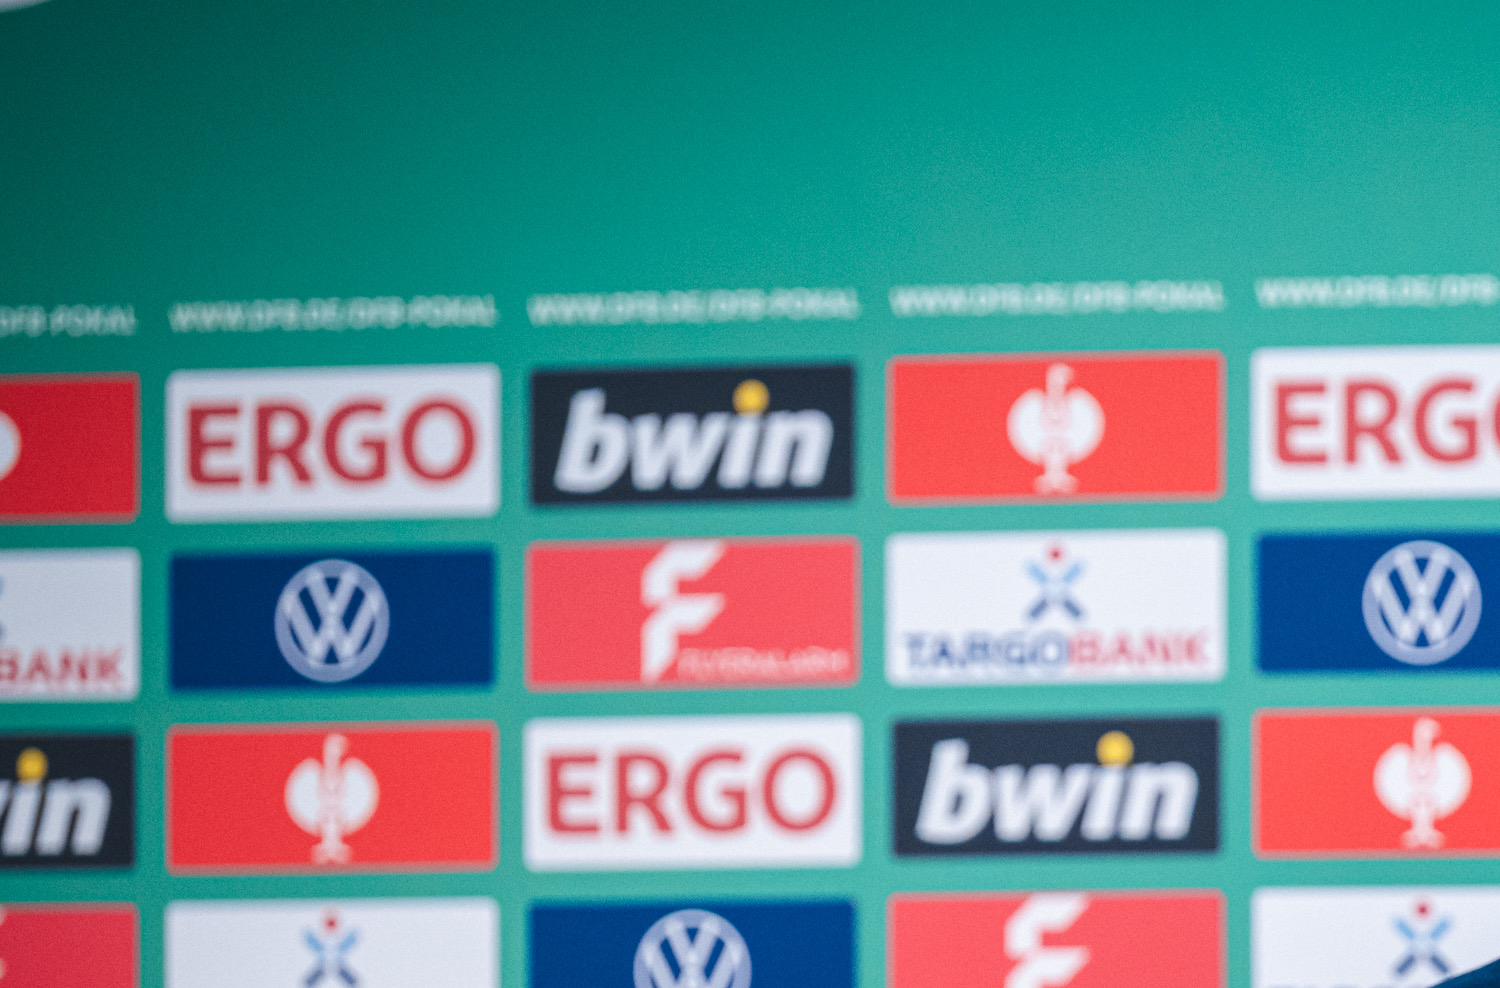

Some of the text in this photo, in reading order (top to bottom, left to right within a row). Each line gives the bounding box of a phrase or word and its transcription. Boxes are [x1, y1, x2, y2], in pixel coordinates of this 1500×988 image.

[185, 397, 477, 489] ERGO
[556, 382, 832, 492] bwin
[902, 632, 1210, 670] TARGOBANK
[0, 751, 110, 854] in
[545, 747, 838, 837] ERGO
[917, 733, 1197, 843] bwin
